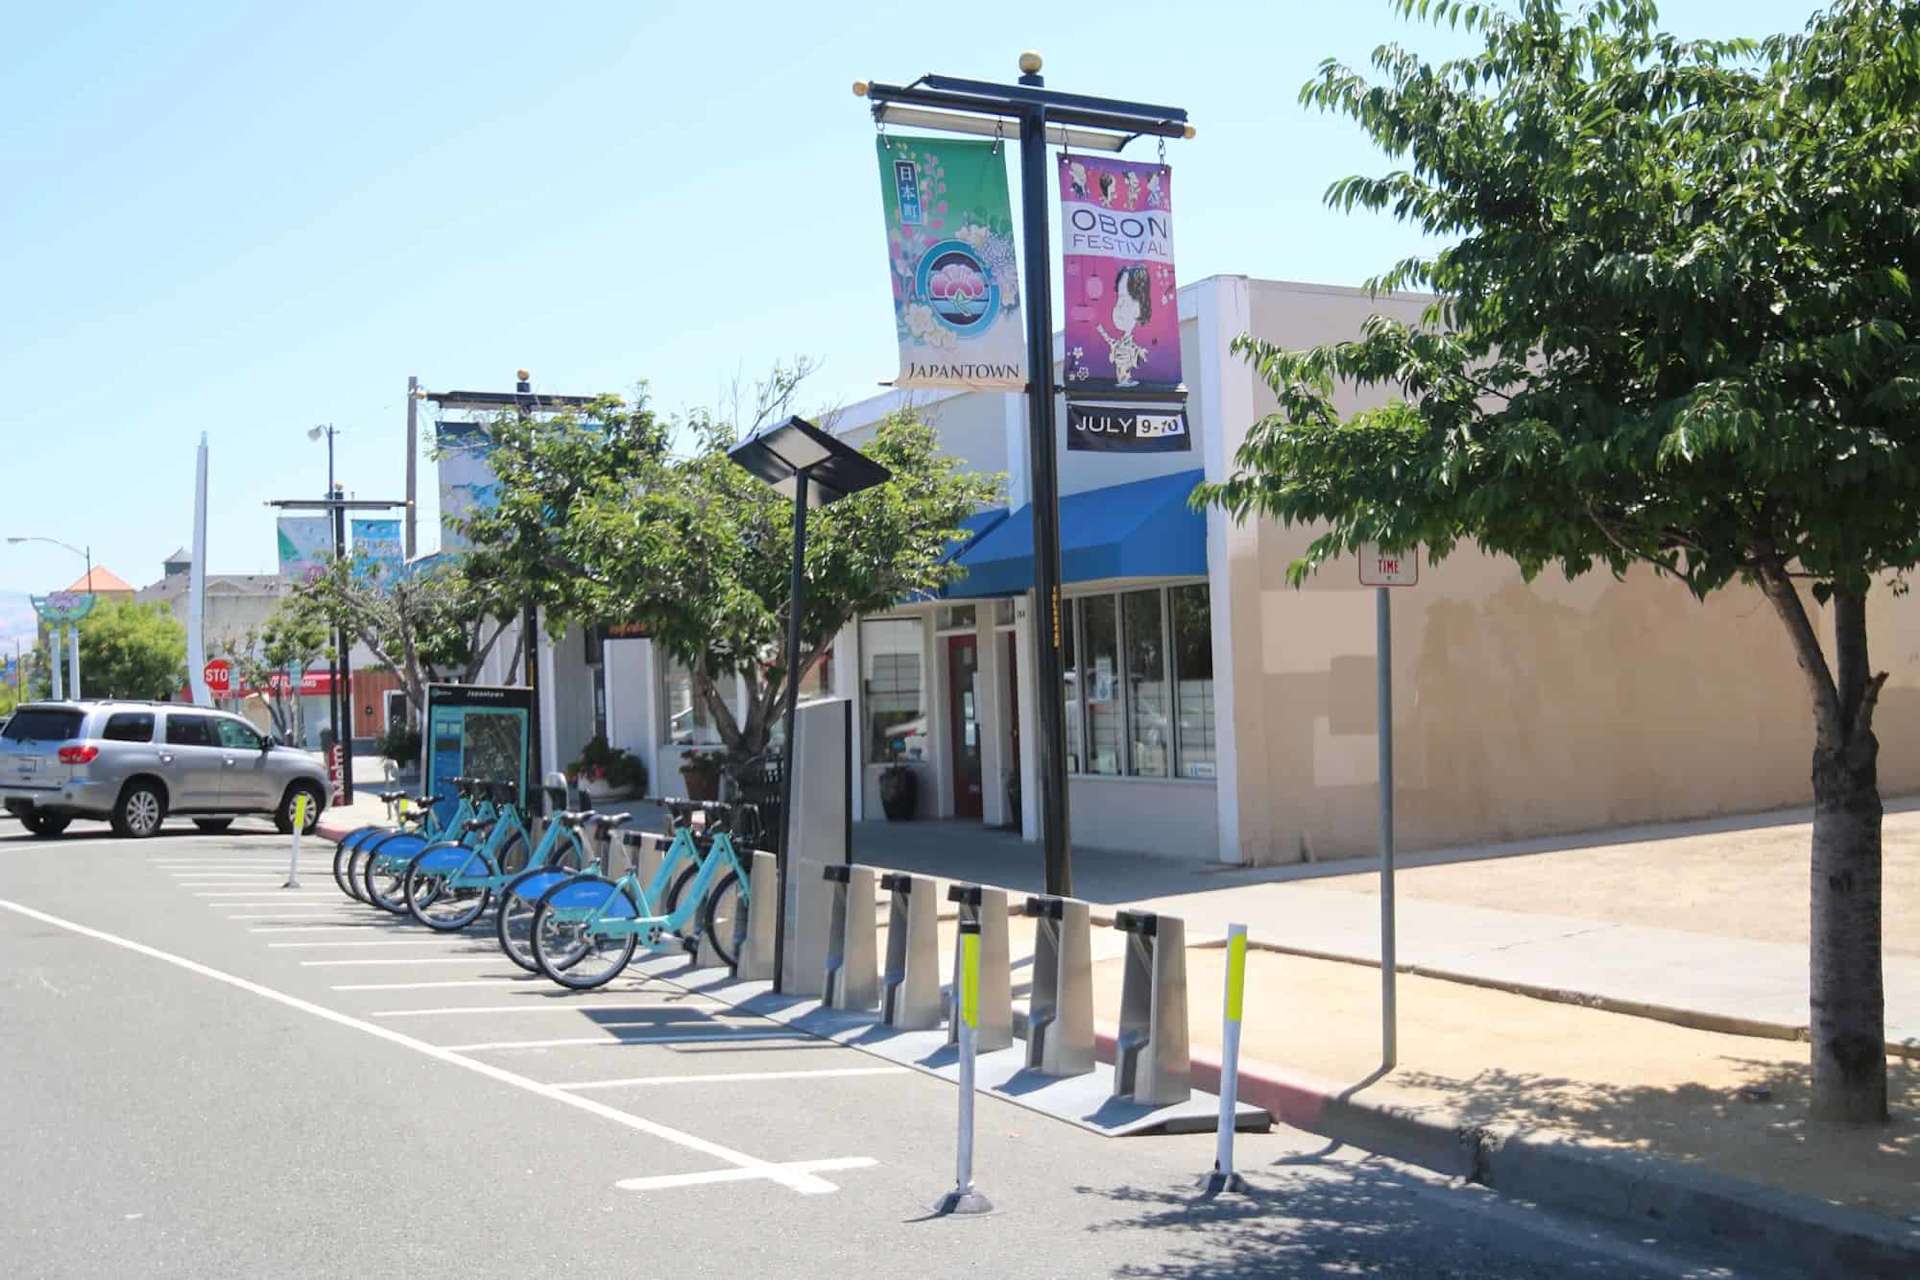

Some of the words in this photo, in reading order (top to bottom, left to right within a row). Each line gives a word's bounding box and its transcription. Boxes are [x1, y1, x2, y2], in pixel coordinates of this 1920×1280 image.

[900, 166, 918, 217] 日本町
[1072, 209, 1167, 239] OBON
[1073, 233, 1167, 256] FESTIVAL
[909, 362, 1020, 379] JAPANTOWN
[1075, 416, 1133, 433] JULY
[1141, 418, 1179, 434] 9-10
[1378, 559, 1399, 574] TIME
[205, 668, 232, 682] STO
